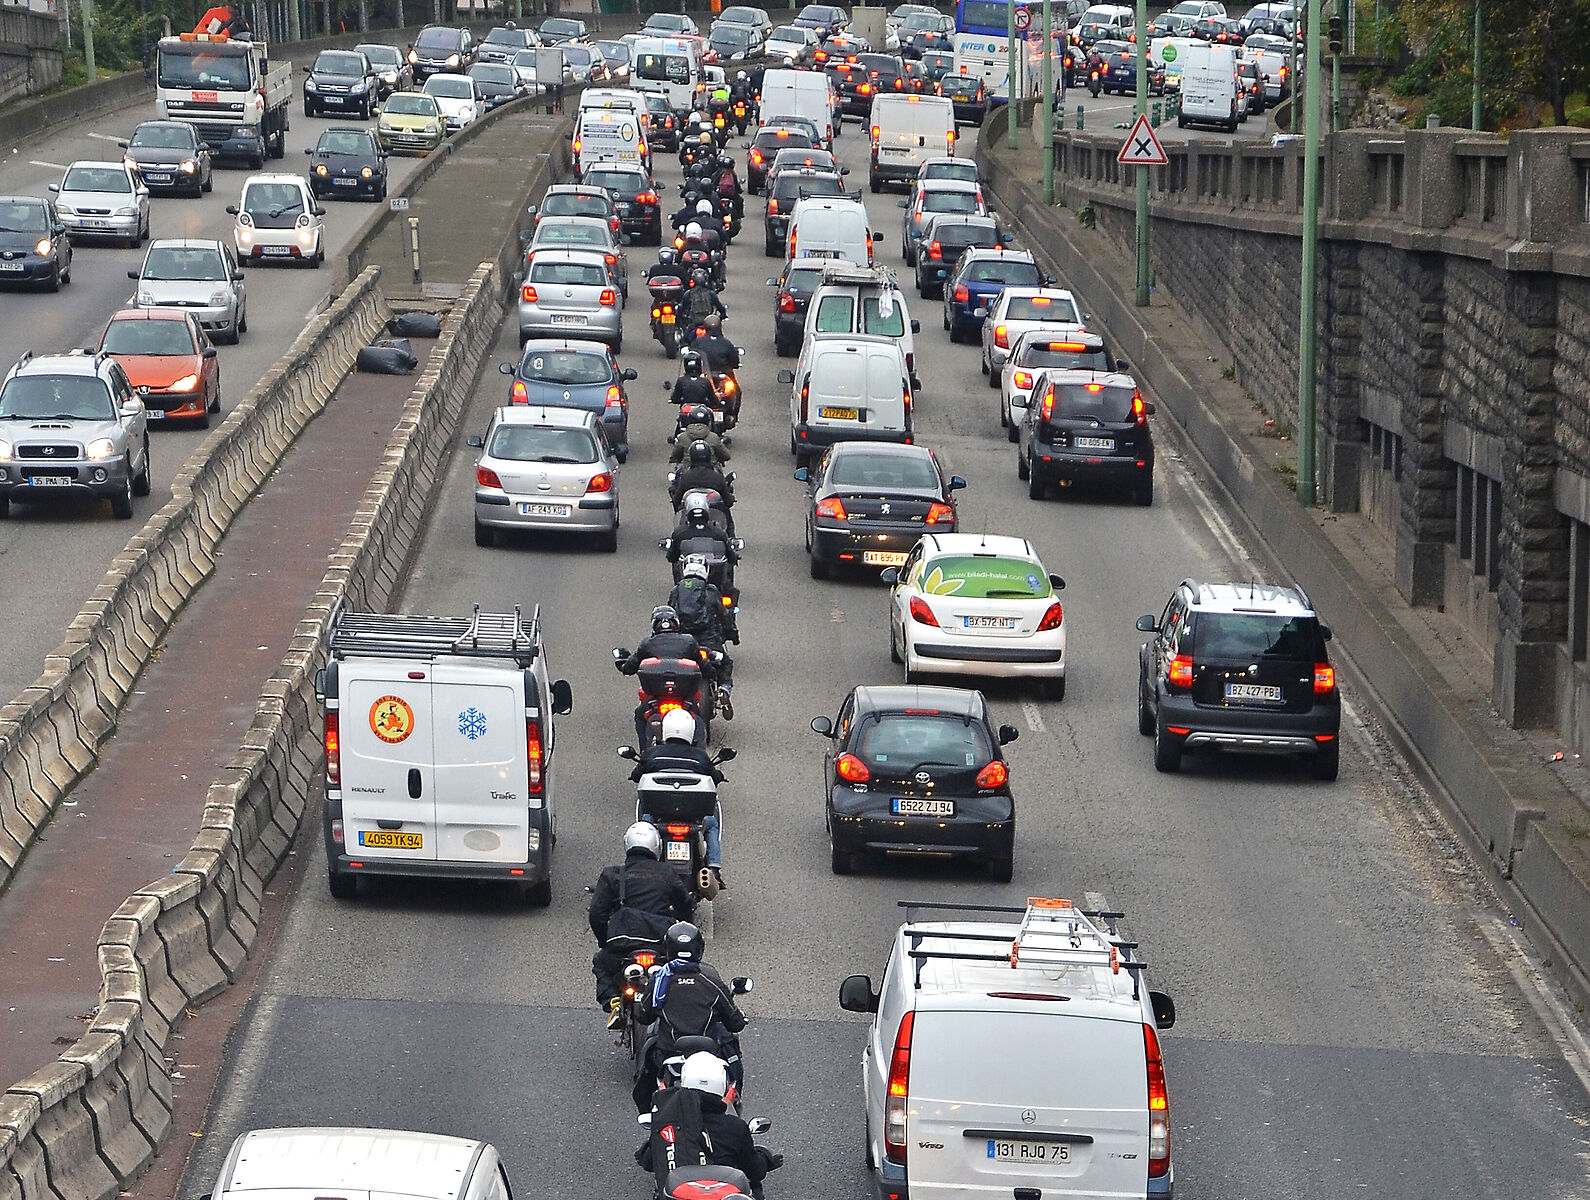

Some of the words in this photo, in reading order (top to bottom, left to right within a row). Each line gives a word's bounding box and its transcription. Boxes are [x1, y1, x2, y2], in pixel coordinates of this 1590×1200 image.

[490, 791, 517, 800] Trafic
[900, 801, 923, 812] 6522
[926, 801, 938, 812] ZJ
[940, 802, 951, 813] 94
[367, 835, 393, 846] 4059
[394, 836, 406, 846] YK
[407, 837, 420, 847] 94
[665, 1142, 676, 1172] Tec
[996, 1143, 1014, 1157] 131
[1021, 1143, 1046, 1159] RJQ
[1052, 1146, 1069, 1160] 75
